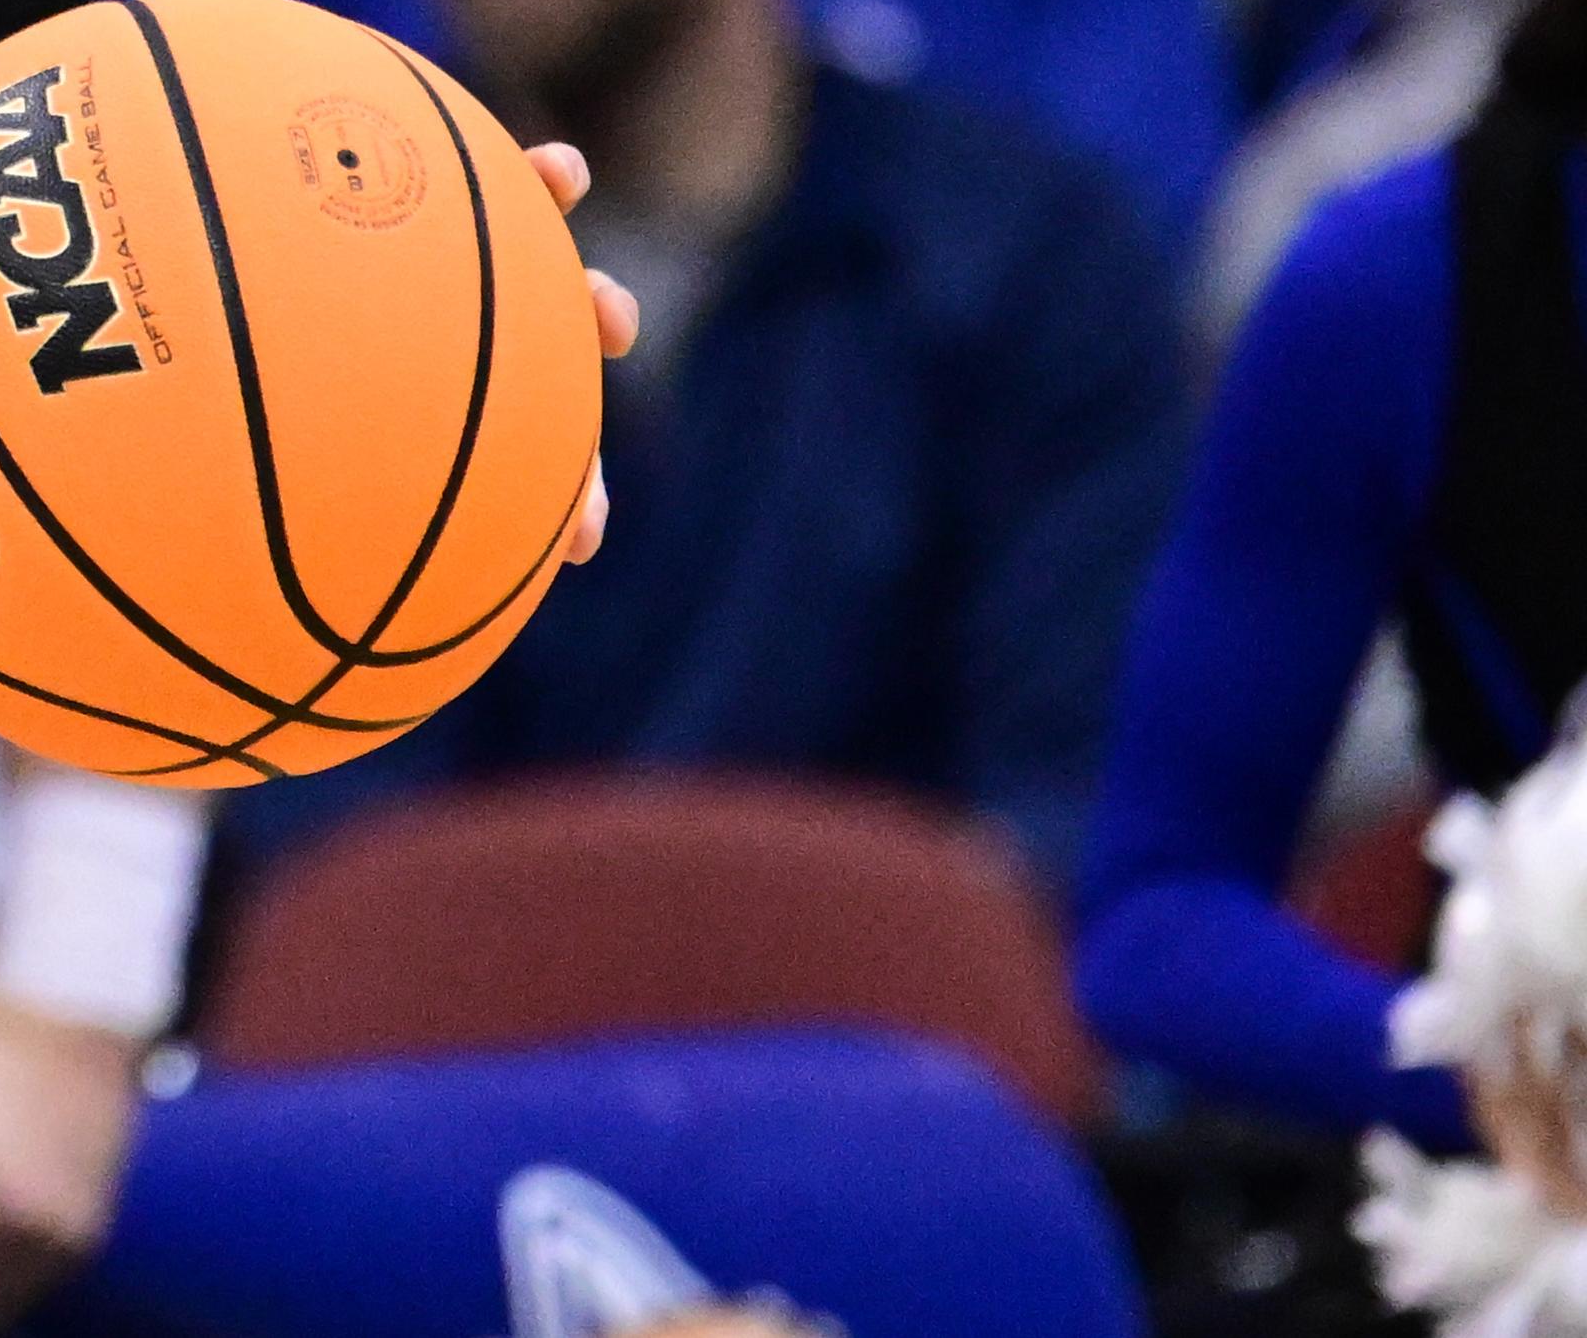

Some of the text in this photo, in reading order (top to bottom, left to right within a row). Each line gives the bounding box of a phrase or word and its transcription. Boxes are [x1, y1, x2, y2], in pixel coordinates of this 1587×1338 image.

[77, 57, 173, 365] OFFICIAL GAME BALL
